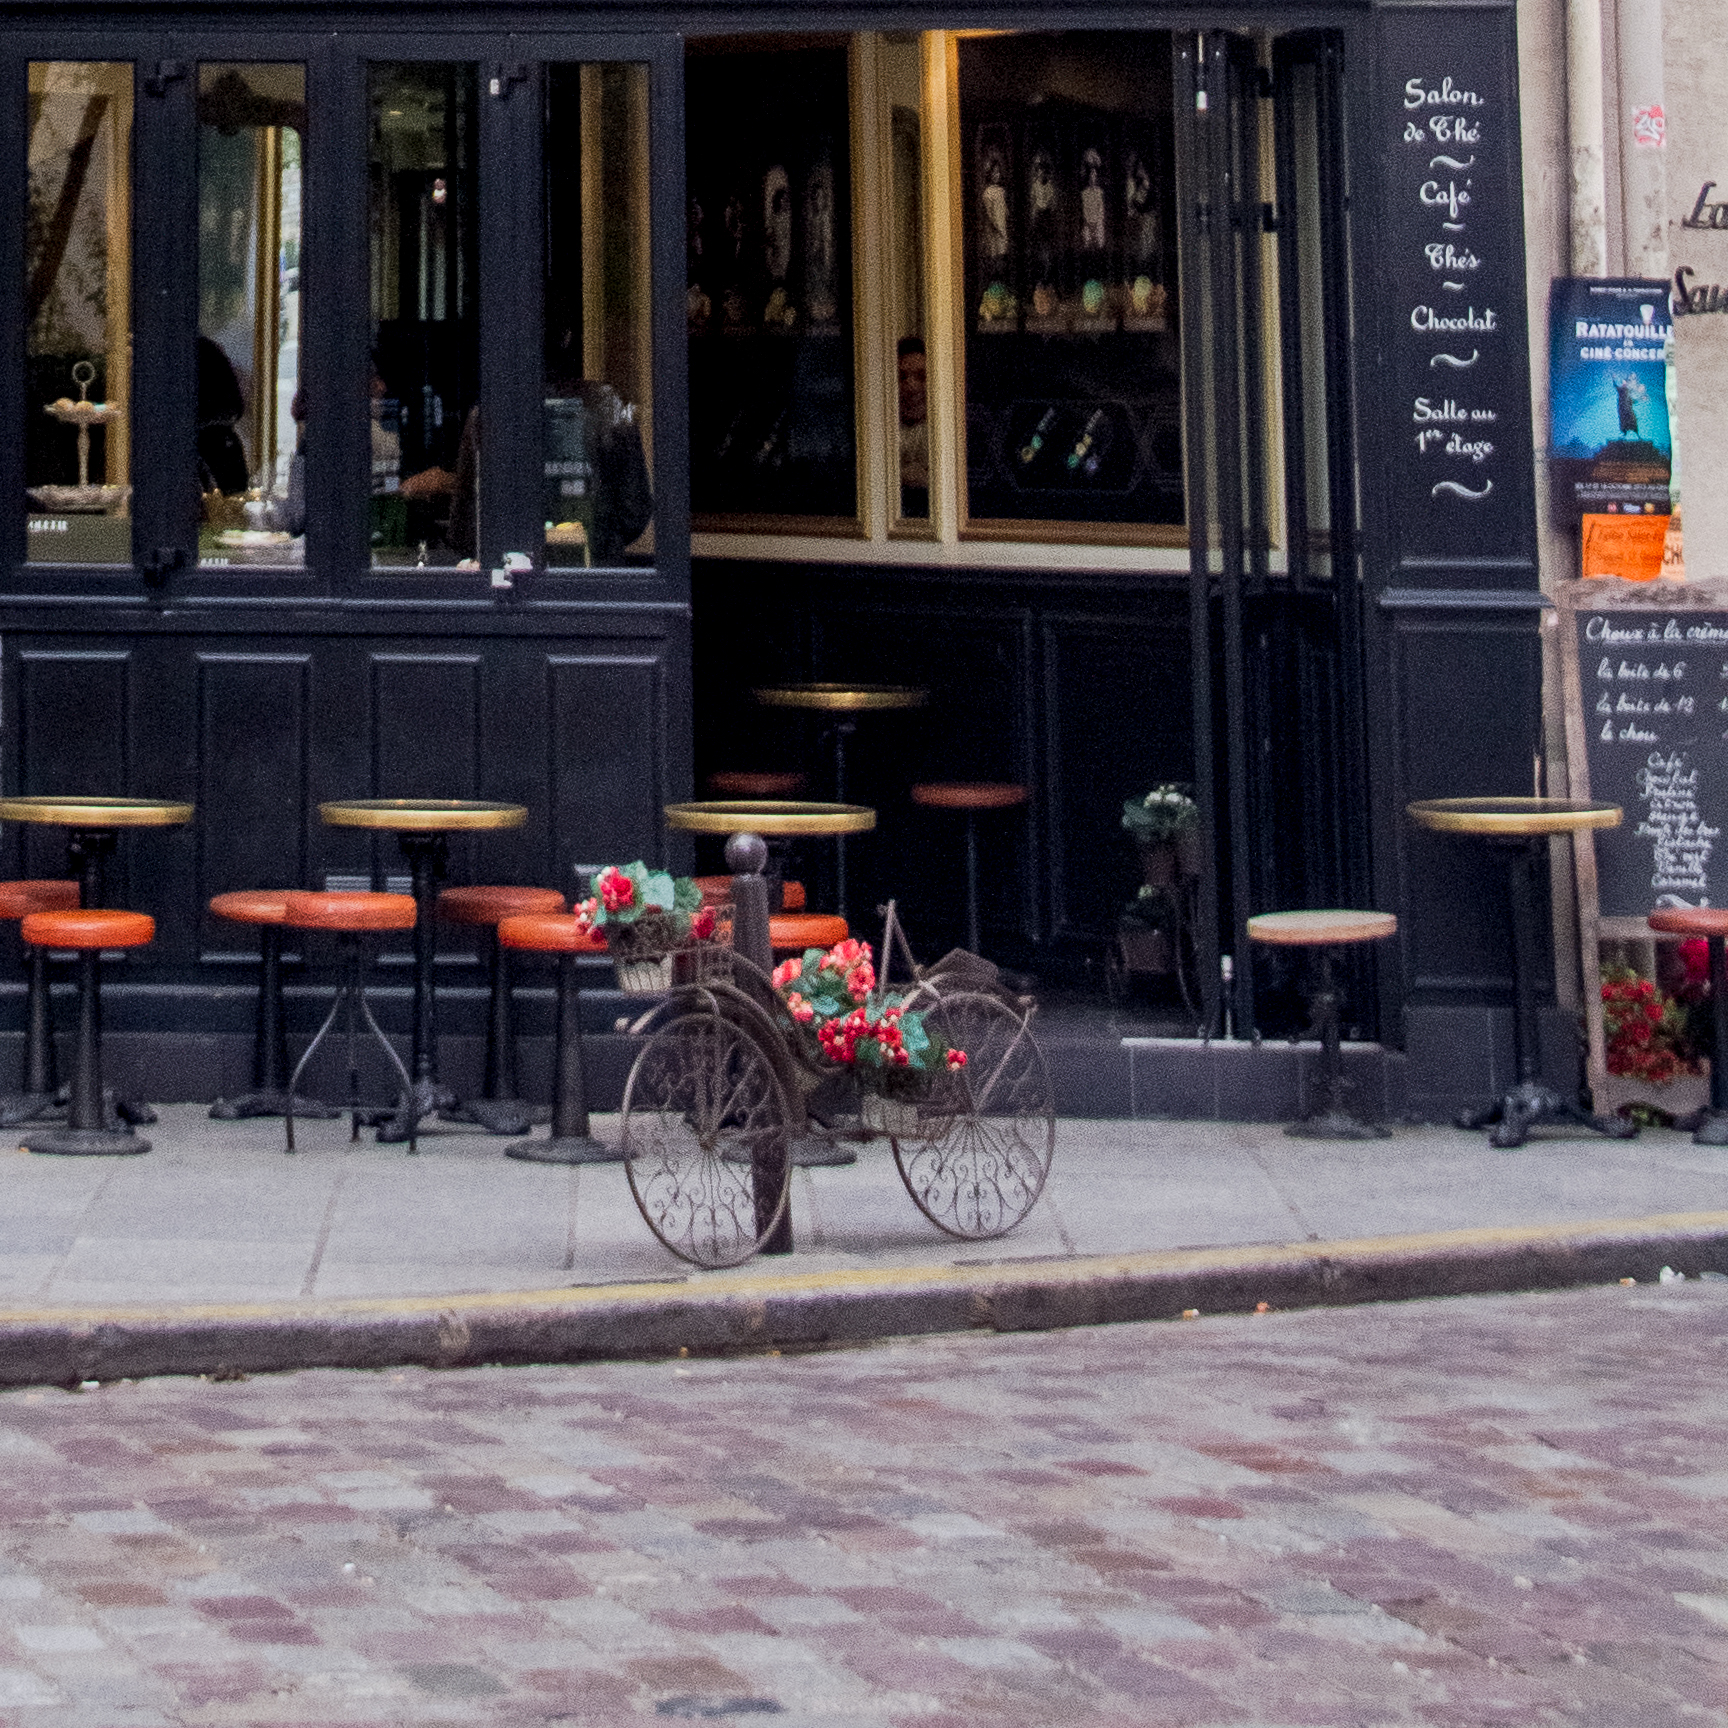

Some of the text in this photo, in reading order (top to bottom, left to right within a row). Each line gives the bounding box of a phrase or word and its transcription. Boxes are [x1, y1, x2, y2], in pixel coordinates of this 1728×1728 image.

[1403, 76, 1485, 110] Salon
[1403, 115, 1481, 143] de Thé
[1419, 178, 1472, 219] Café
[1411, 305, 1497, 332] Chocolat
[1413, 396, 1497, 422] Salle au
[1445, 432, 1494, 462] étage
[1663, 618, 1683, 640] la
